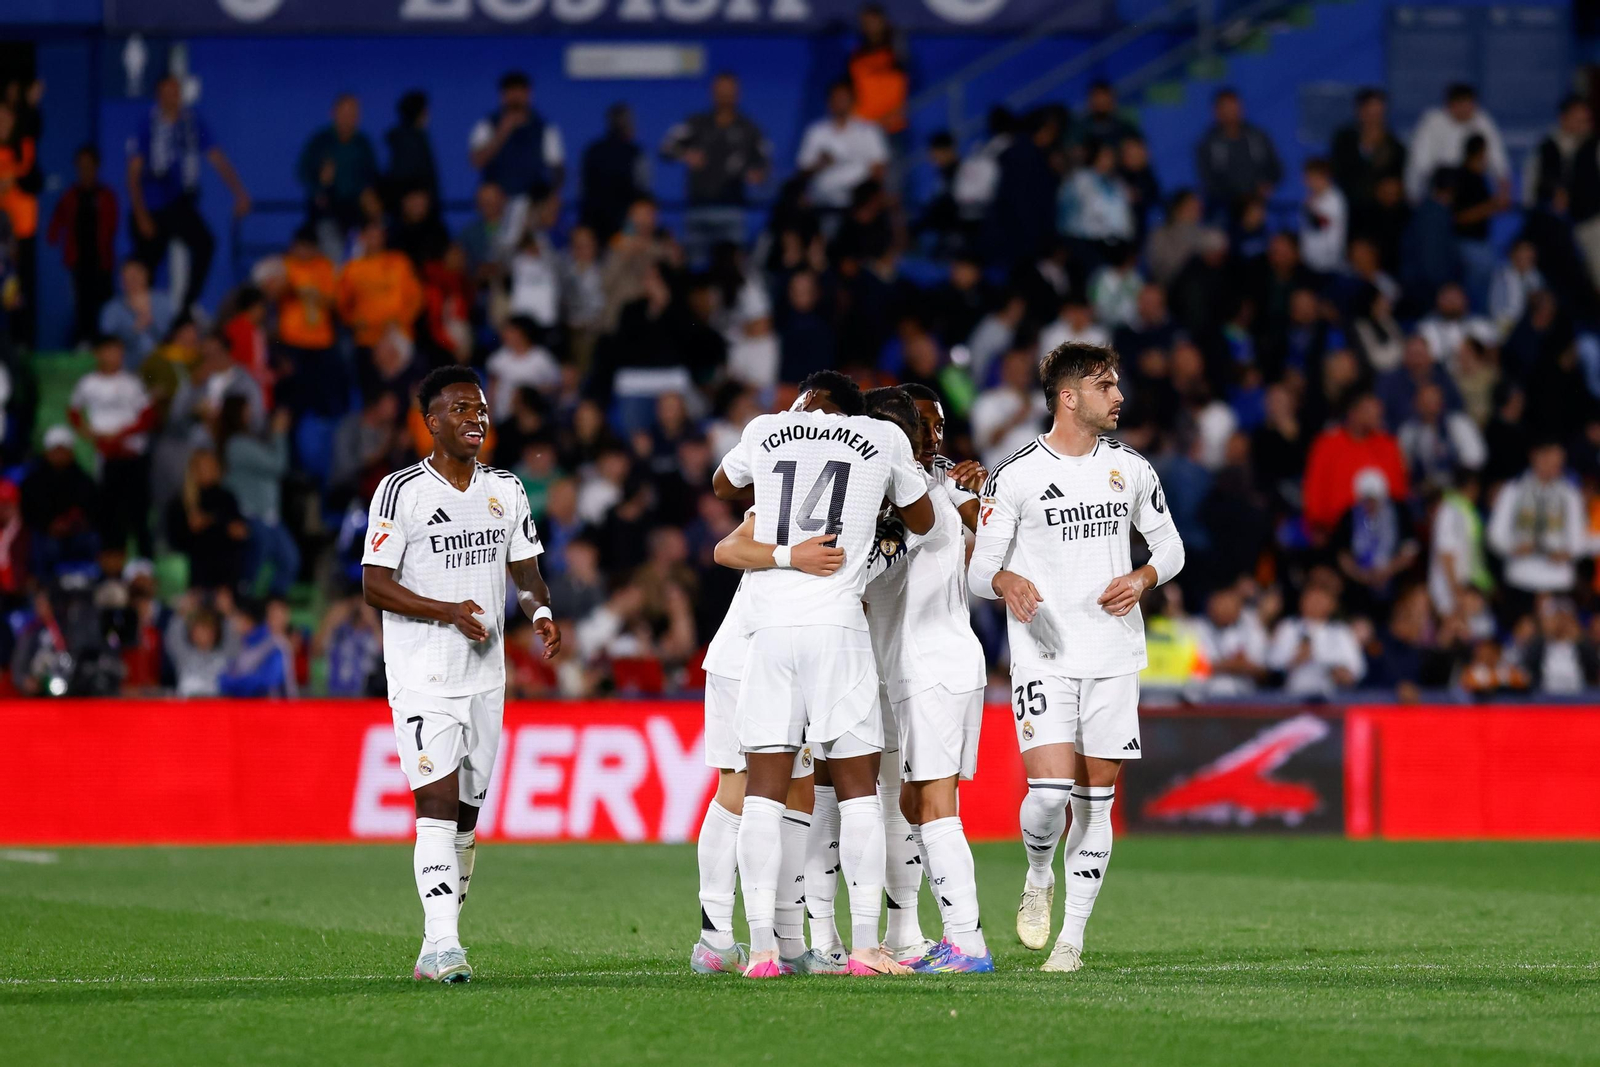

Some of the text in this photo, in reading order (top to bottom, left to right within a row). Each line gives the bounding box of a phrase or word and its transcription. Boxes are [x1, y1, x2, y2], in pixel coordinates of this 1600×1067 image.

[760, 425, 879, 461] TCHOUAMENI
[772, 460, 851, 548] 14
[1044, 501, 1129, 526] Emirates
[430, 528, 506, 553] Emirates
[1062, 520, 1119, 542] FLY BETTER
[445, 547, 497, 569] FLY BETTER
[1014, 680, 1048, 721] 35
[406, 715, 424, 751] 7
[350, 716, 712, 844] EERY
[1079, 850, 1110, 859] RMCF
[422, 864, 452, 875] RMCF
